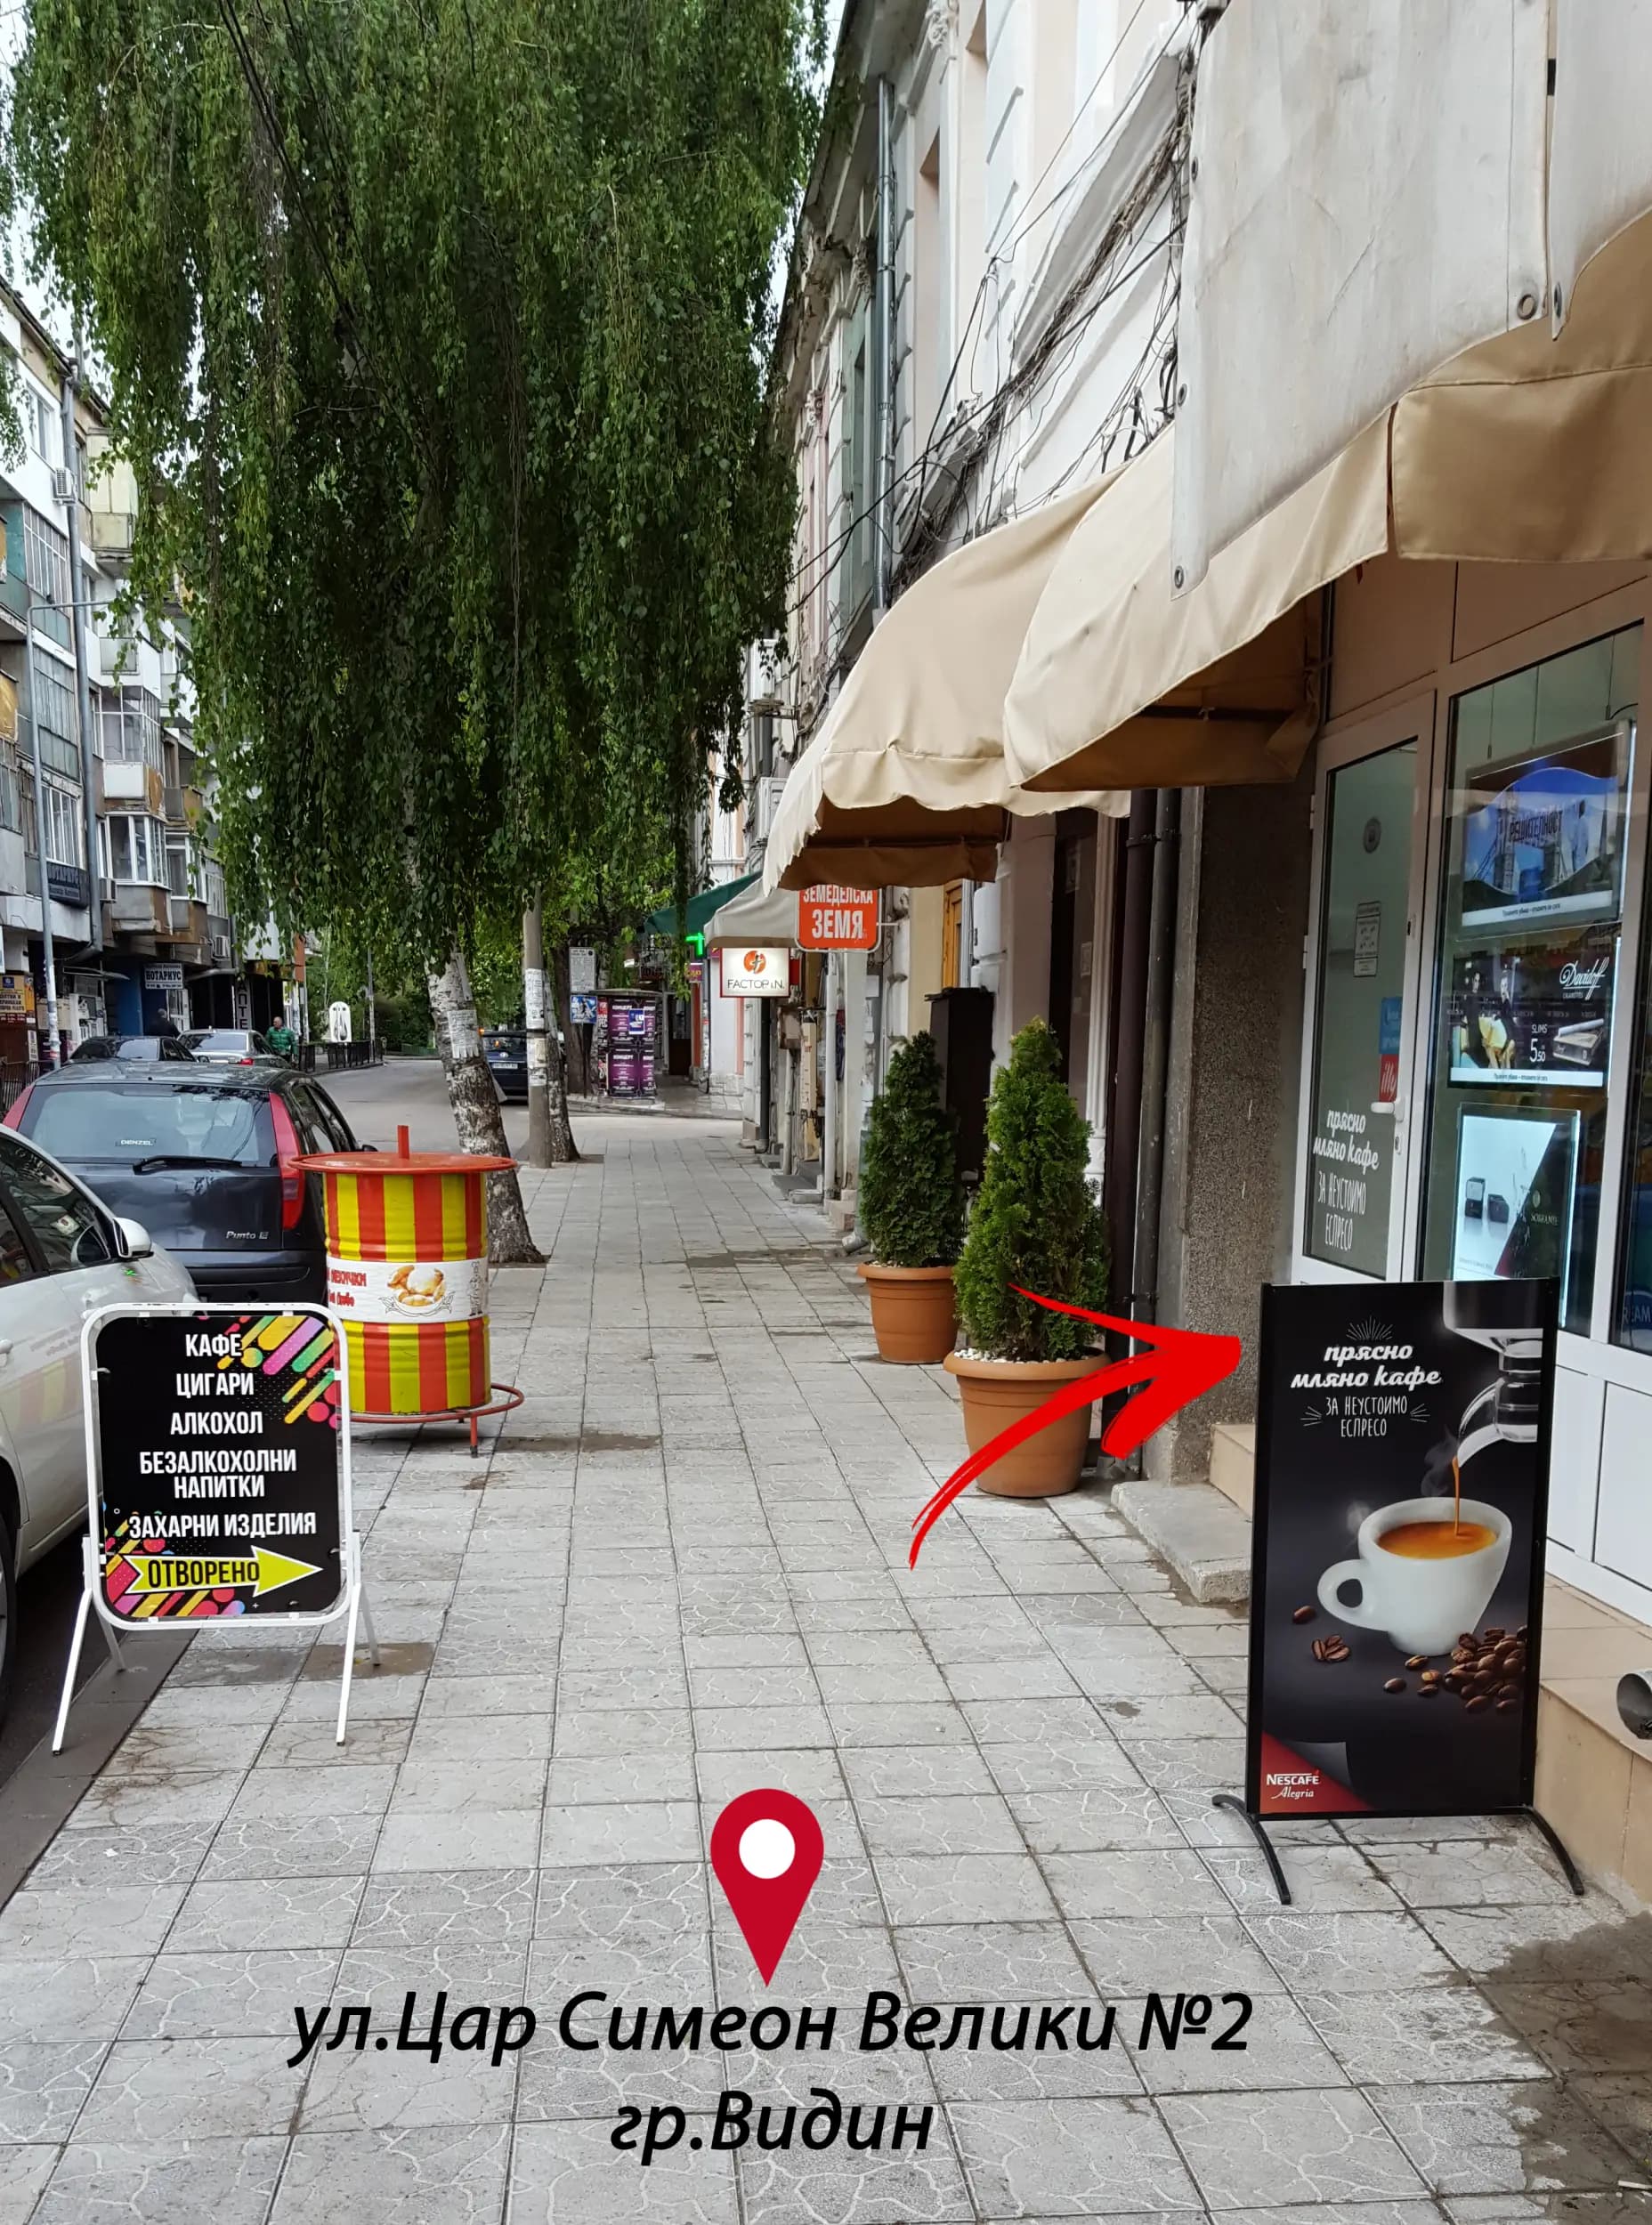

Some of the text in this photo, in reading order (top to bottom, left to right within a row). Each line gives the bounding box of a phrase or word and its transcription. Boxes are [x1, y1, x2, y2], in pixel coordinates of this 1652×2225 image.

[804, 885, 873, 907] ЗЕМЕДЕЛСКА
[812, 909, 863, 939] ЗЕМЯ
[1559, 957, 1609, 1000] Davidoff
[1326, 1110, 1366, 1137] прясно
[1313, 1135, 1380, 1175] мляно кафе
[1318, 1170, 1367, 1216] ЗА НЕУСТОИМО
[226, 1230, 257, 1240] Punto
[1324, 1212, 1354, 1251] ЕСПРЕСО
[185, 1333, 242, 1357] КАФЕ
[1323, 1344, 1413, 1368] прясно
[176, 1372, 255, 1399] ЦИГАРИ
[1291, 1364, 1442, 1392] мляно кафе
[1325, 1395, 1408, 1416] ЗА НЕУСТОИМО
[170, 1412, 263, 1436] АЛКОХОЛ
[1340, 1418, 1387, 1438] ЕСПРЕСО
[140, 1449, 297, 1475] БЕЗАЛКОХОЛНИ
[174, 1475, 265, 1500] НАПИТКИ
[128, 1512, 317, 1540] ЗАХАРНИ ИЗДЕЛИЯ
[147, 1559, 260, 1589] ОТВОРЕНО
[1271, 1786, 1315, 1800] Alegria
